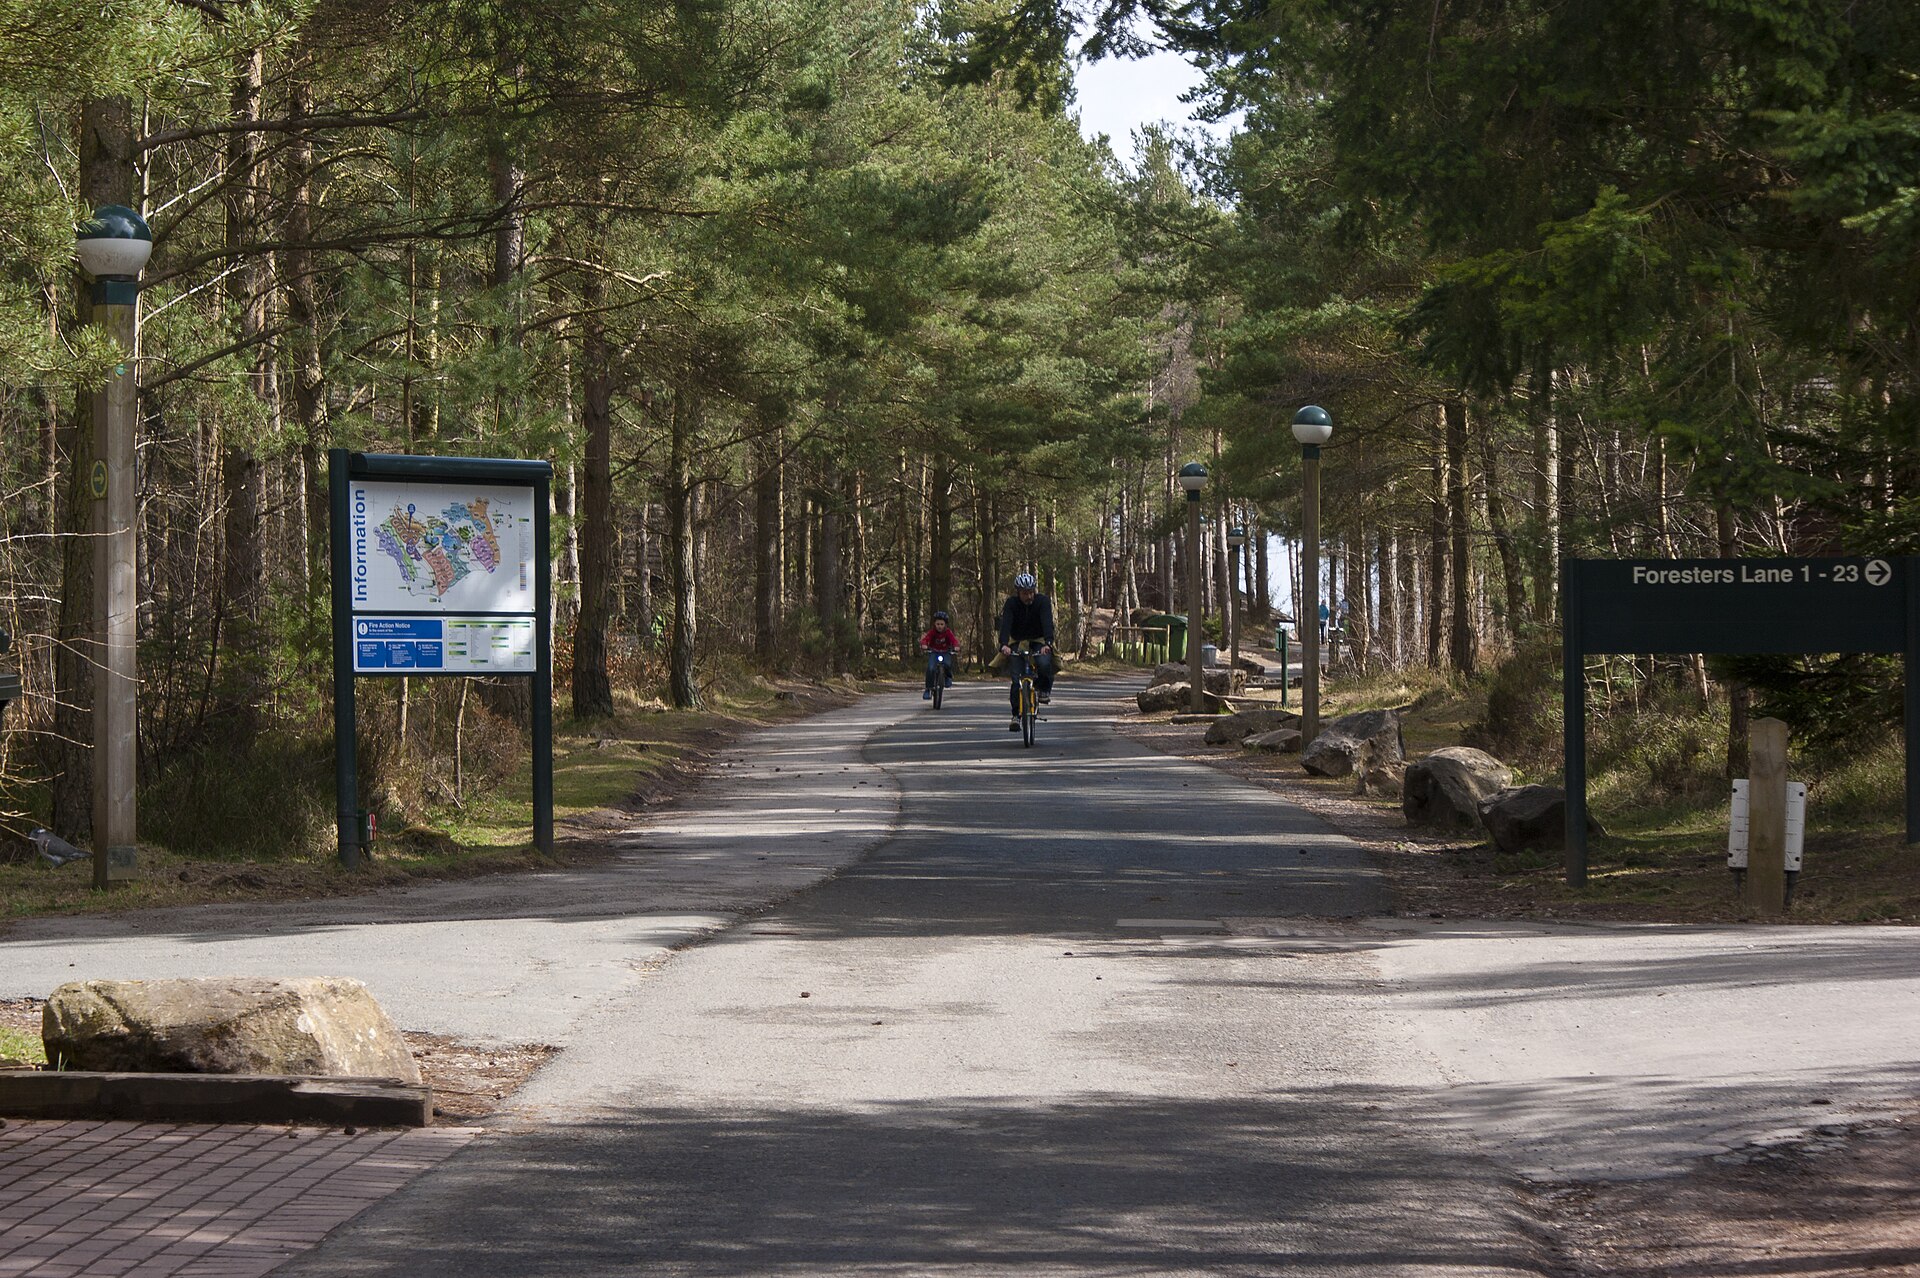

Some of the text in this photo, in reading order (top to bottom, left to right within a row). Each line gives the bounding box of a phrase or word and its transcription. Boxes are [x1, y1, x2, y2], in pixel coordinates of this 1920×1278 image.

[353, 490, 367, 601] Information
[1633, 565, 1735, 585] Foresters
[1741, 565, 1793, 583] Lane
[1801, 565, 1810, 582] 1
[1832, 564, 1859, 583] 23
